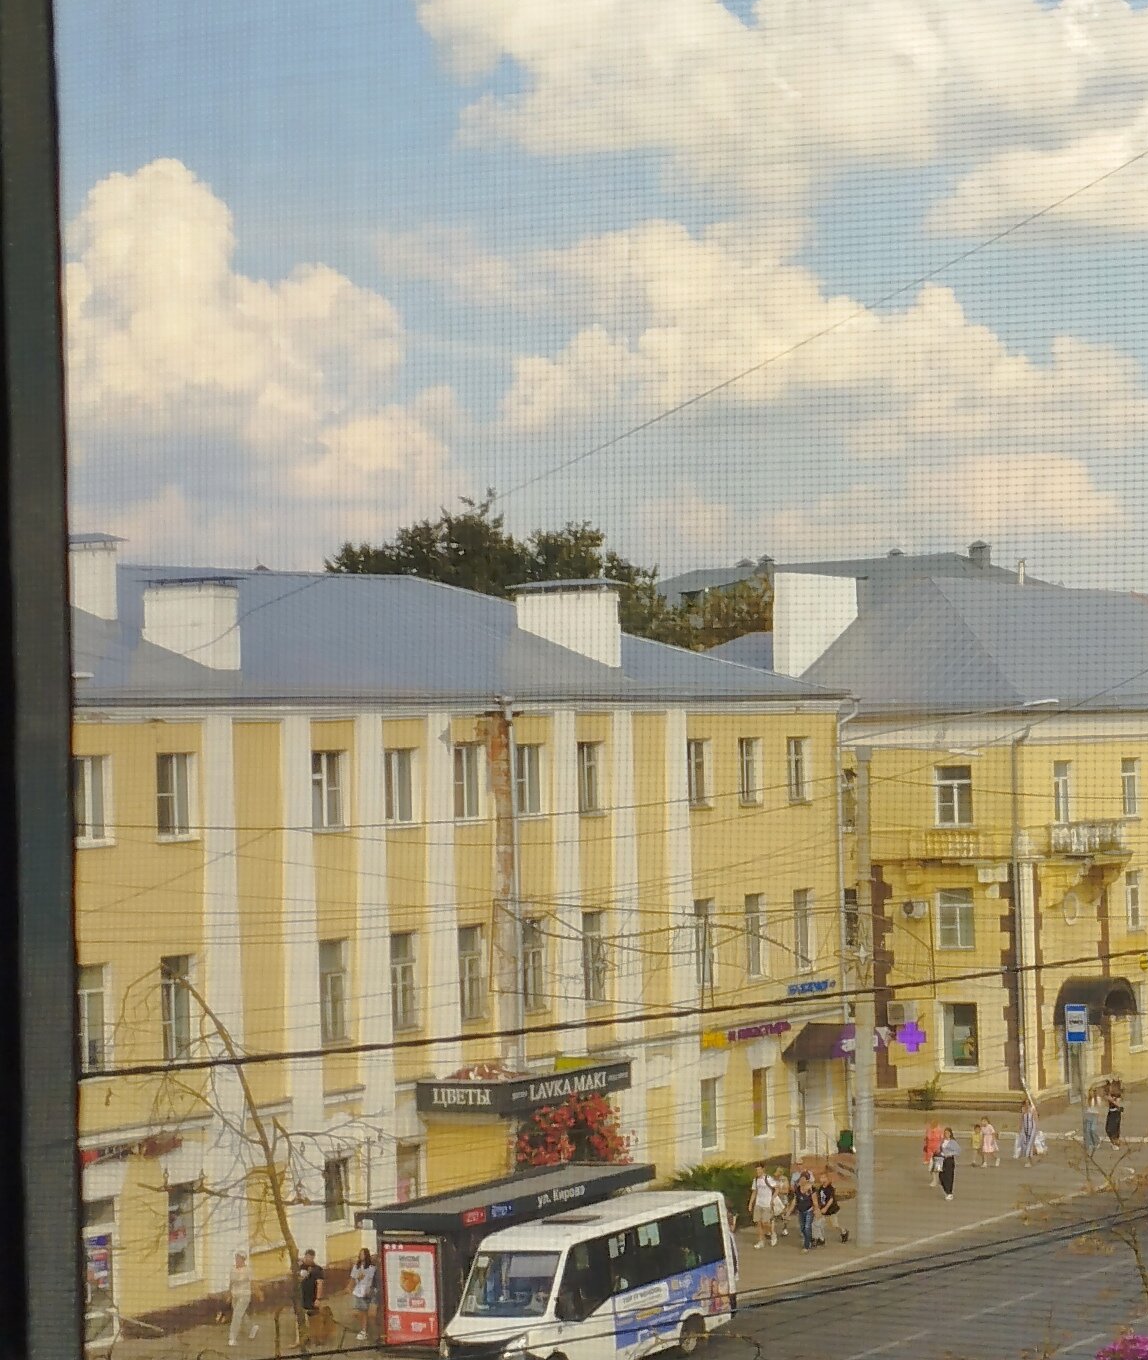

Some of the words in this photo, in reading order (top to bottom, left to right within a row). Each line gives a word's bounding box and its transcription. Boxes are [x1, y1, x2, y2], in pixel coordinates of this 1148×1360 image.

[529, 1078, 572, 1101] LAVKA
[573, 1071, 608, 1094] MAKI
[432, 1087, 492, 1108] ЦВЕТЫ
[553, 1185, 585, 1202] Кирова
